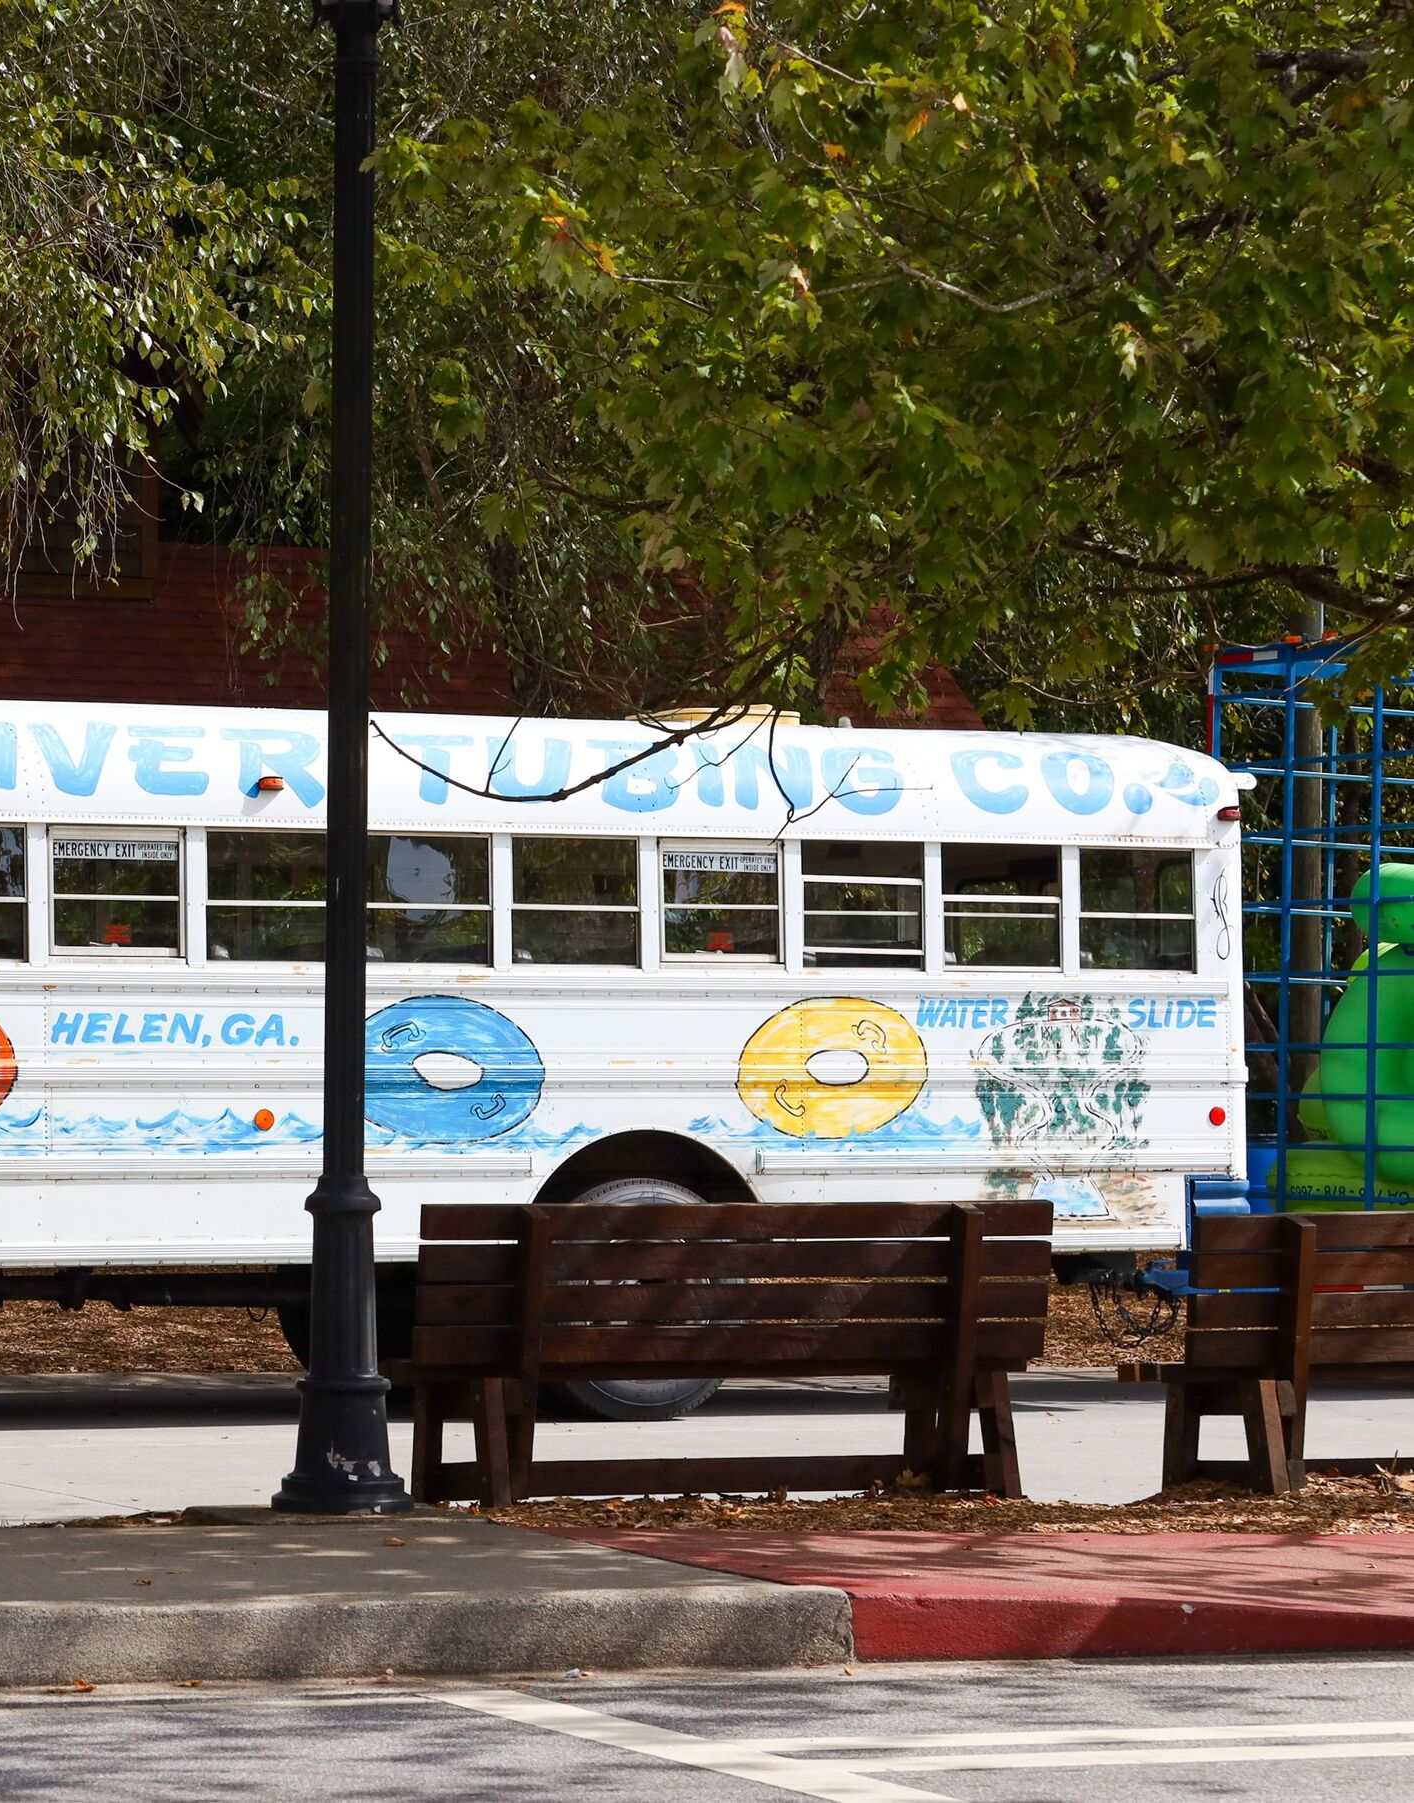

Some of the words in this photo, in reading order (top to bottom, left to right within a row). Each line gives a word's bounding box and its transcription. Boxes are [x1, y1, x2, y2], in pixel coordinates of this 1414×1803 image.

[392, 733, 905, 816] TUBING
[52, 841, 110, 857] EMERGENCY
[115, 843, 137, 858] EXIT
[137, 842, 163, 851] OPERATES
[141, 851, 159, 859] INSIDE
[160, 851, 173, 860] ONLY
[662, 853, 715, 869] EMERGENCY
[719, 856, 739, 870] EXIT
[739, 855, 763, 864] OPERATES
[743, 864, 759, 872] INSIDE
[760, 864, 772, 872] ONLY
[915, 996, 1010, 1030] WATER
